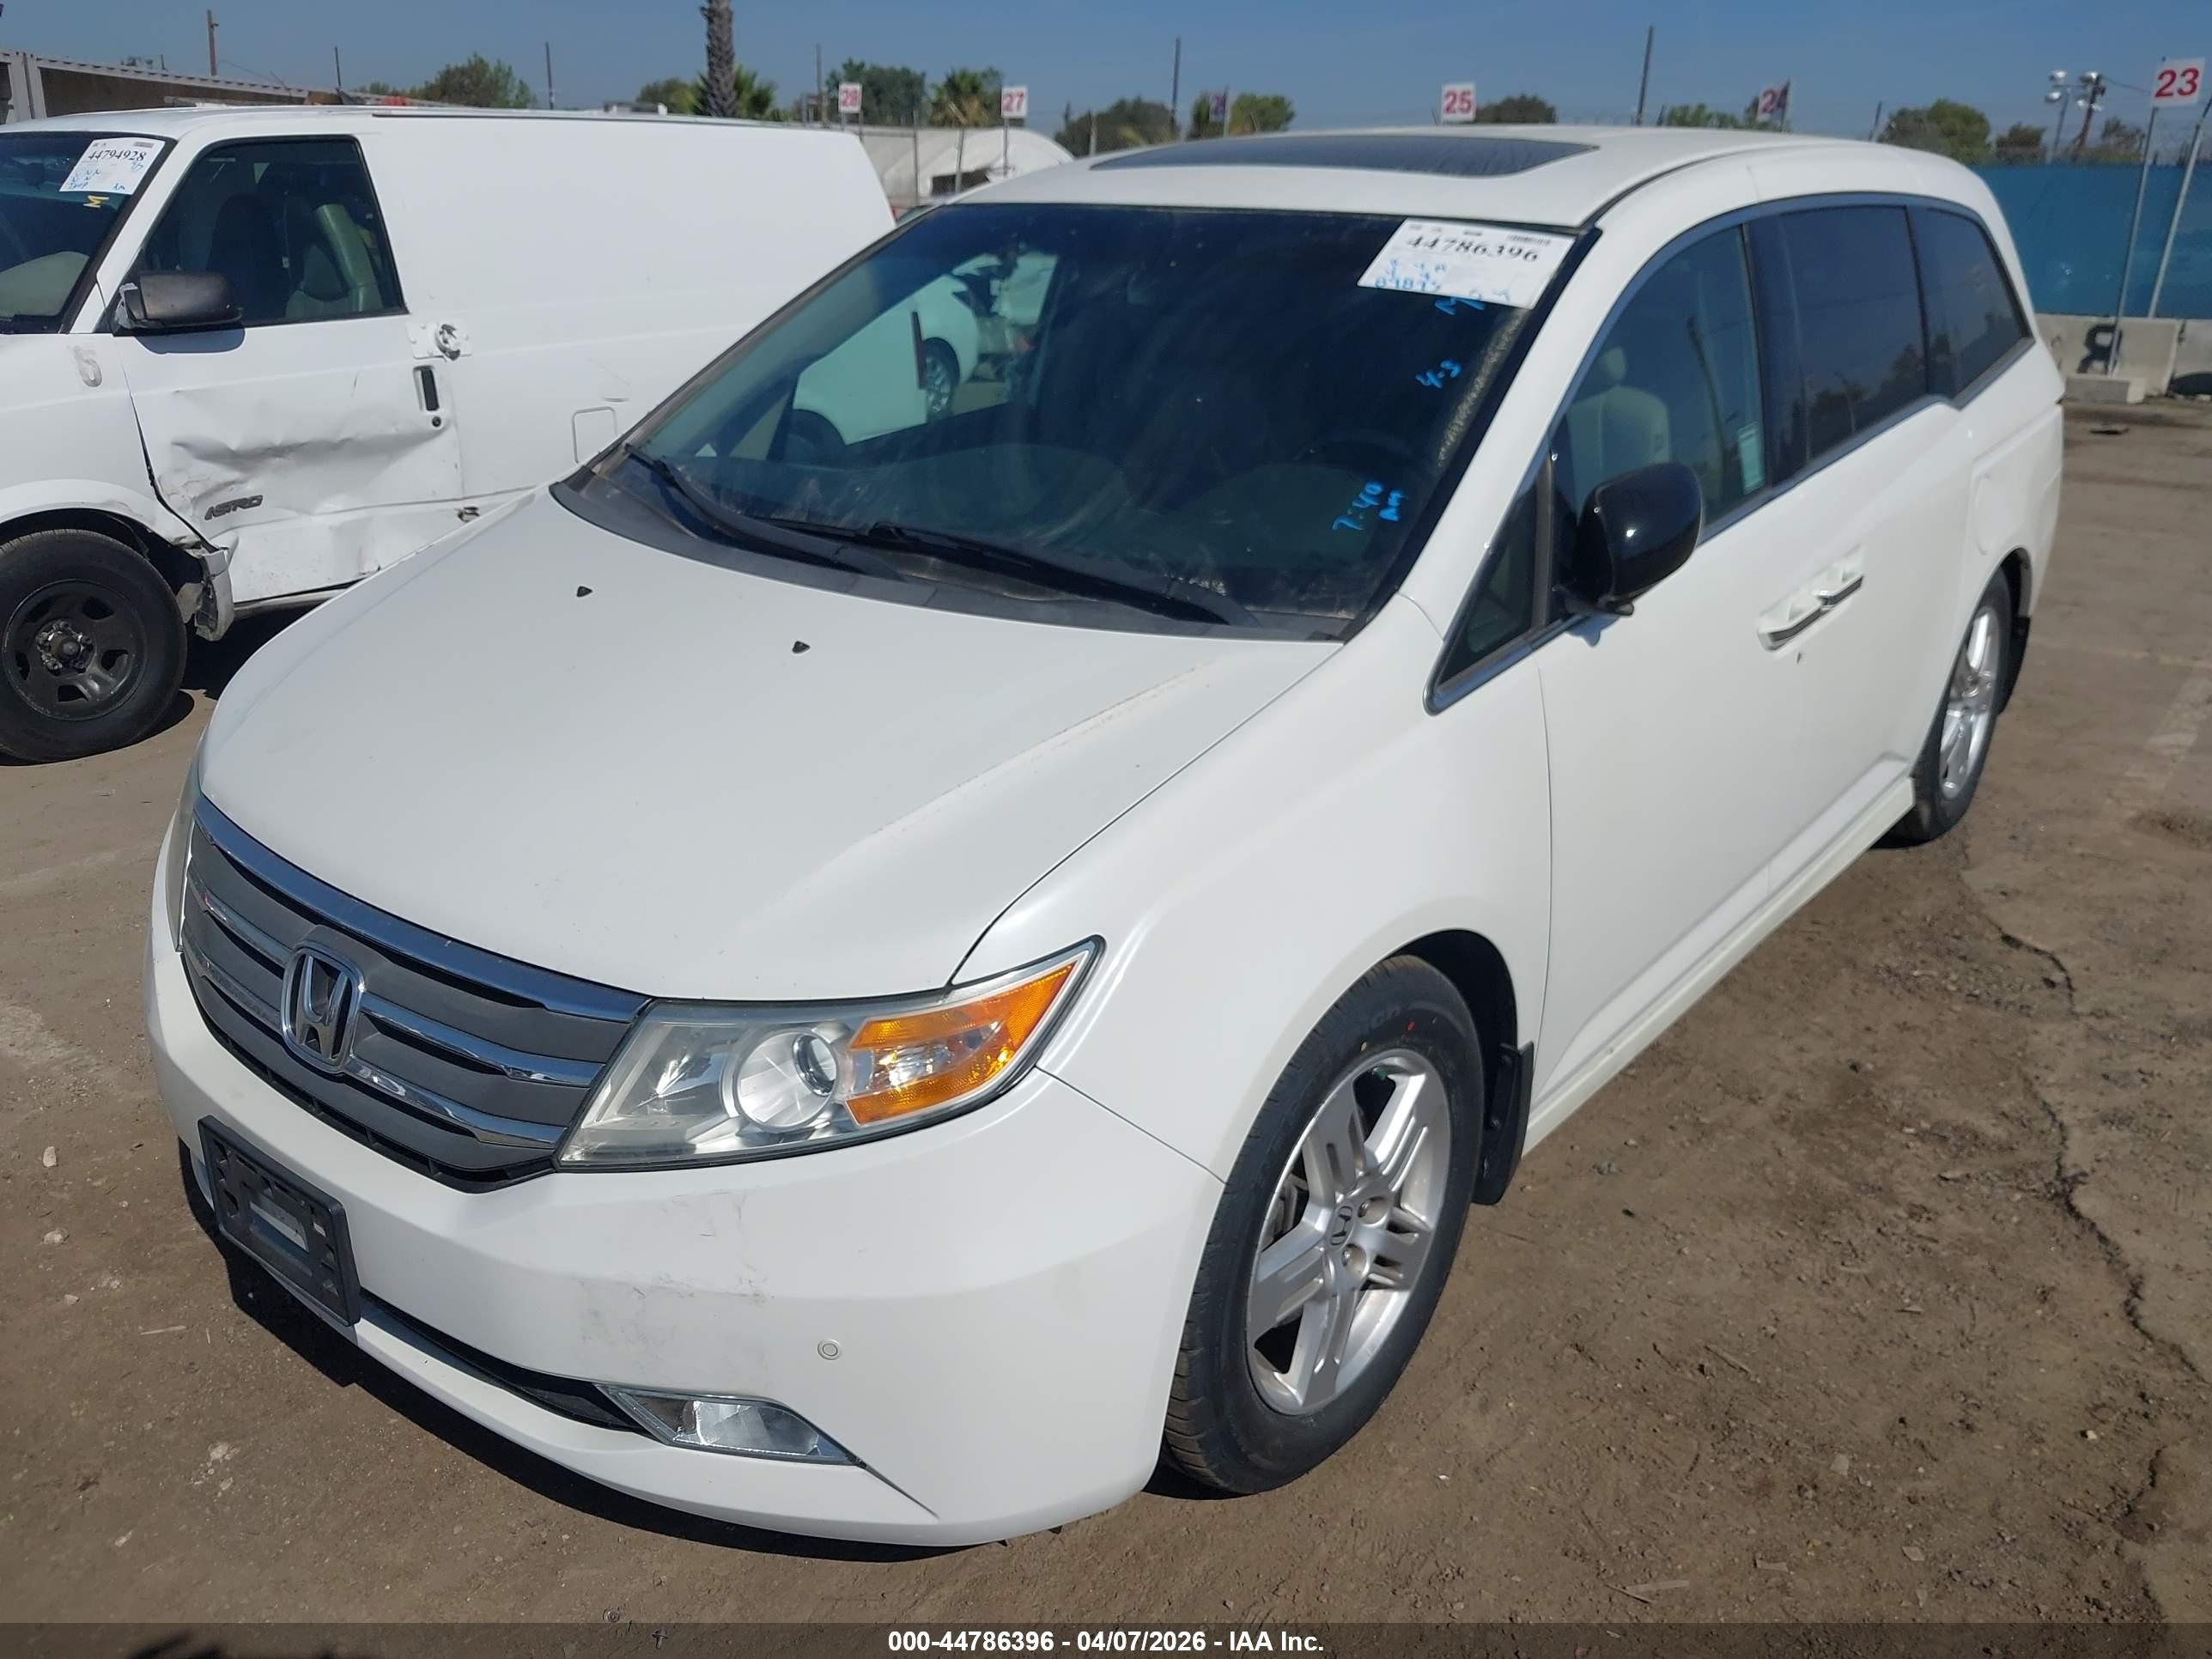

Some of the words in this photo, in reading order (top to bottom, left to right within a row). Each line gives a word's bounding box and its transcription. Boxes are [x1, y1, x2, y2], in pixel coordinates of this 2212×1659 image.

[2154, 67, 2200, 98] 23
[1002, 91, 1024, 112] 27
[1444, 89, 1472, 115] 25
[88, 149, 147, 161] 44794928
[1407, 235, 1539, 263] 44786396
